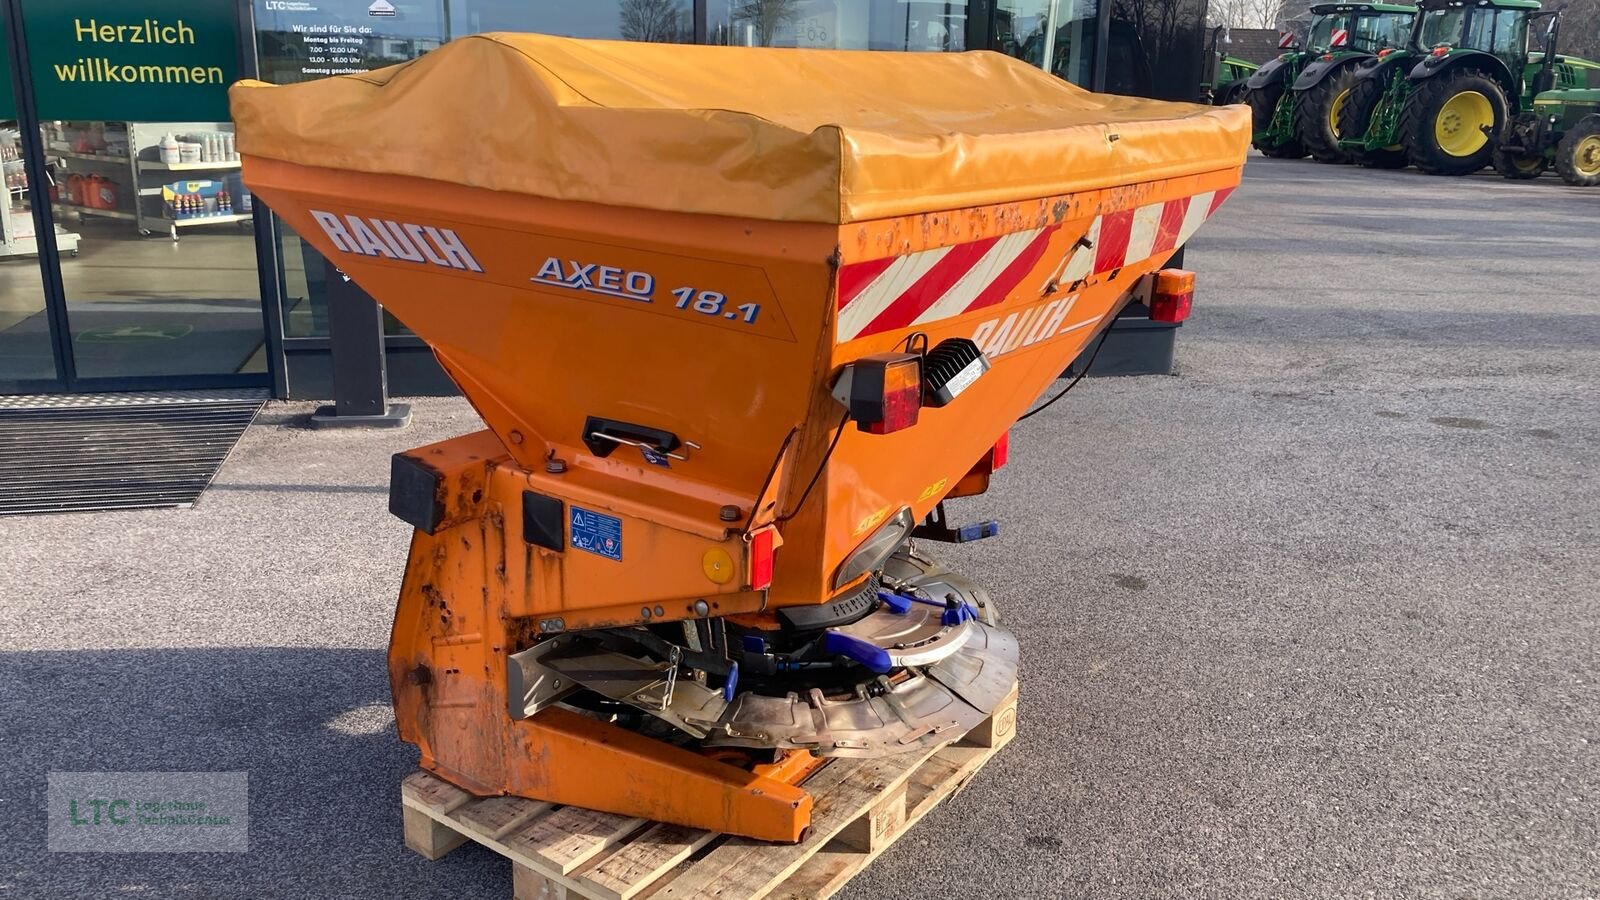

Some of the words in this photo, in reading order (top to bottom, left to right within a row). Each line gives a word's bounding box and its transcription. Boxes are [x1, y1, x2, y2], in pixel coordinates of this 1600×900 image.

[265, 1, 286, 10] LTC
[74, 18, 195, 44] Herzlich
[292, 25, 308, 33] Wir
[309, 25, 328, 33] sind
[329, 25, 342, 33] für
[54, 58, 224, 84] willkommen
[310, 210, 484, 272] RAUCH
[530, 257, 655, 302] AXEO
[671, 286, 762, 324] 18.1
[970, 294, 1080, 360] RAUCH
